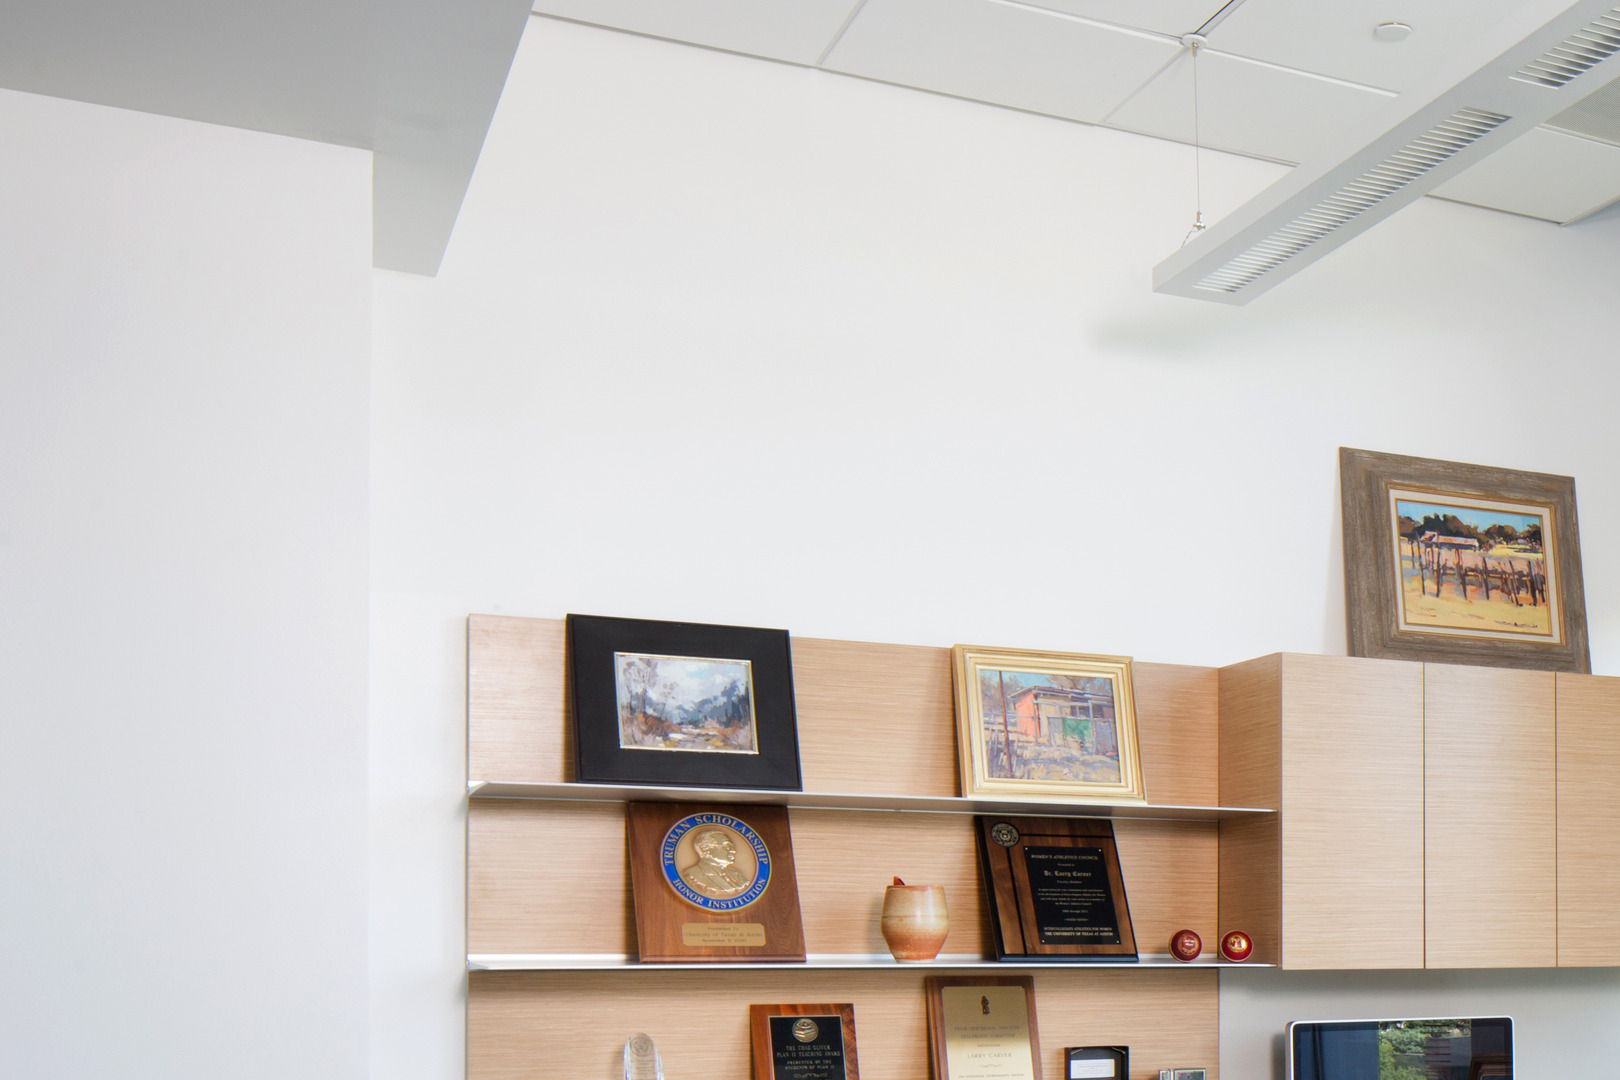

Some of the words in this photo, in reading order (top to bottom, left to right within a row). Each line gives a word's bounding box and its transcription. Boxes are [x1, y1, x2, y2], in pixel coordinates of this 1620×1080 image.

[664, 821, 691, 866] TRUMAN
[694, 814, 769, 864] SCHOLARSHIP
[673, 878, 704, 905] HONOR
[708, 878, 766, 908] INSTITUTION
